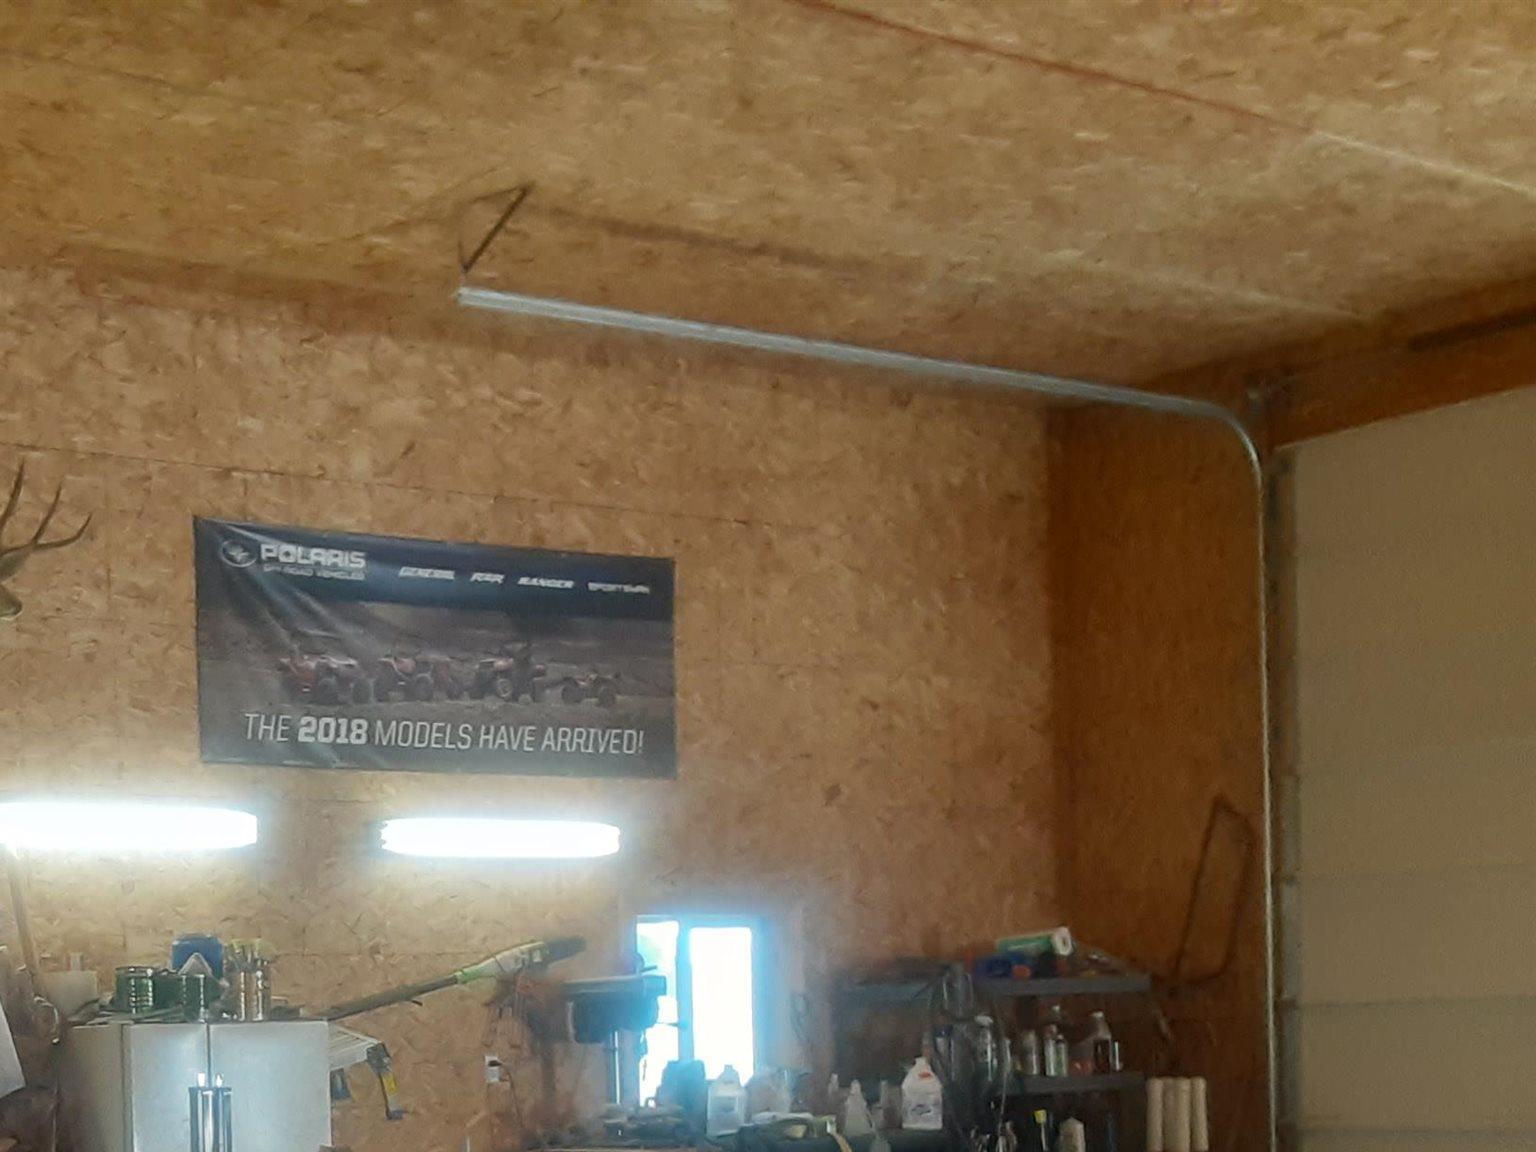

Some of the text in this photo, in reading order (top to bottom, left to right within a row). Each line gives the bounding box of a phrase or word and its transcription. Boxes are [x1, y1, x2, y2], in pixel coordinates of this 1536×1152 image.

[260, 543, 366, 569] POLARIS
[245, 713, 645, 754] THE 2018 MODELS HAVE ARRIVED!
